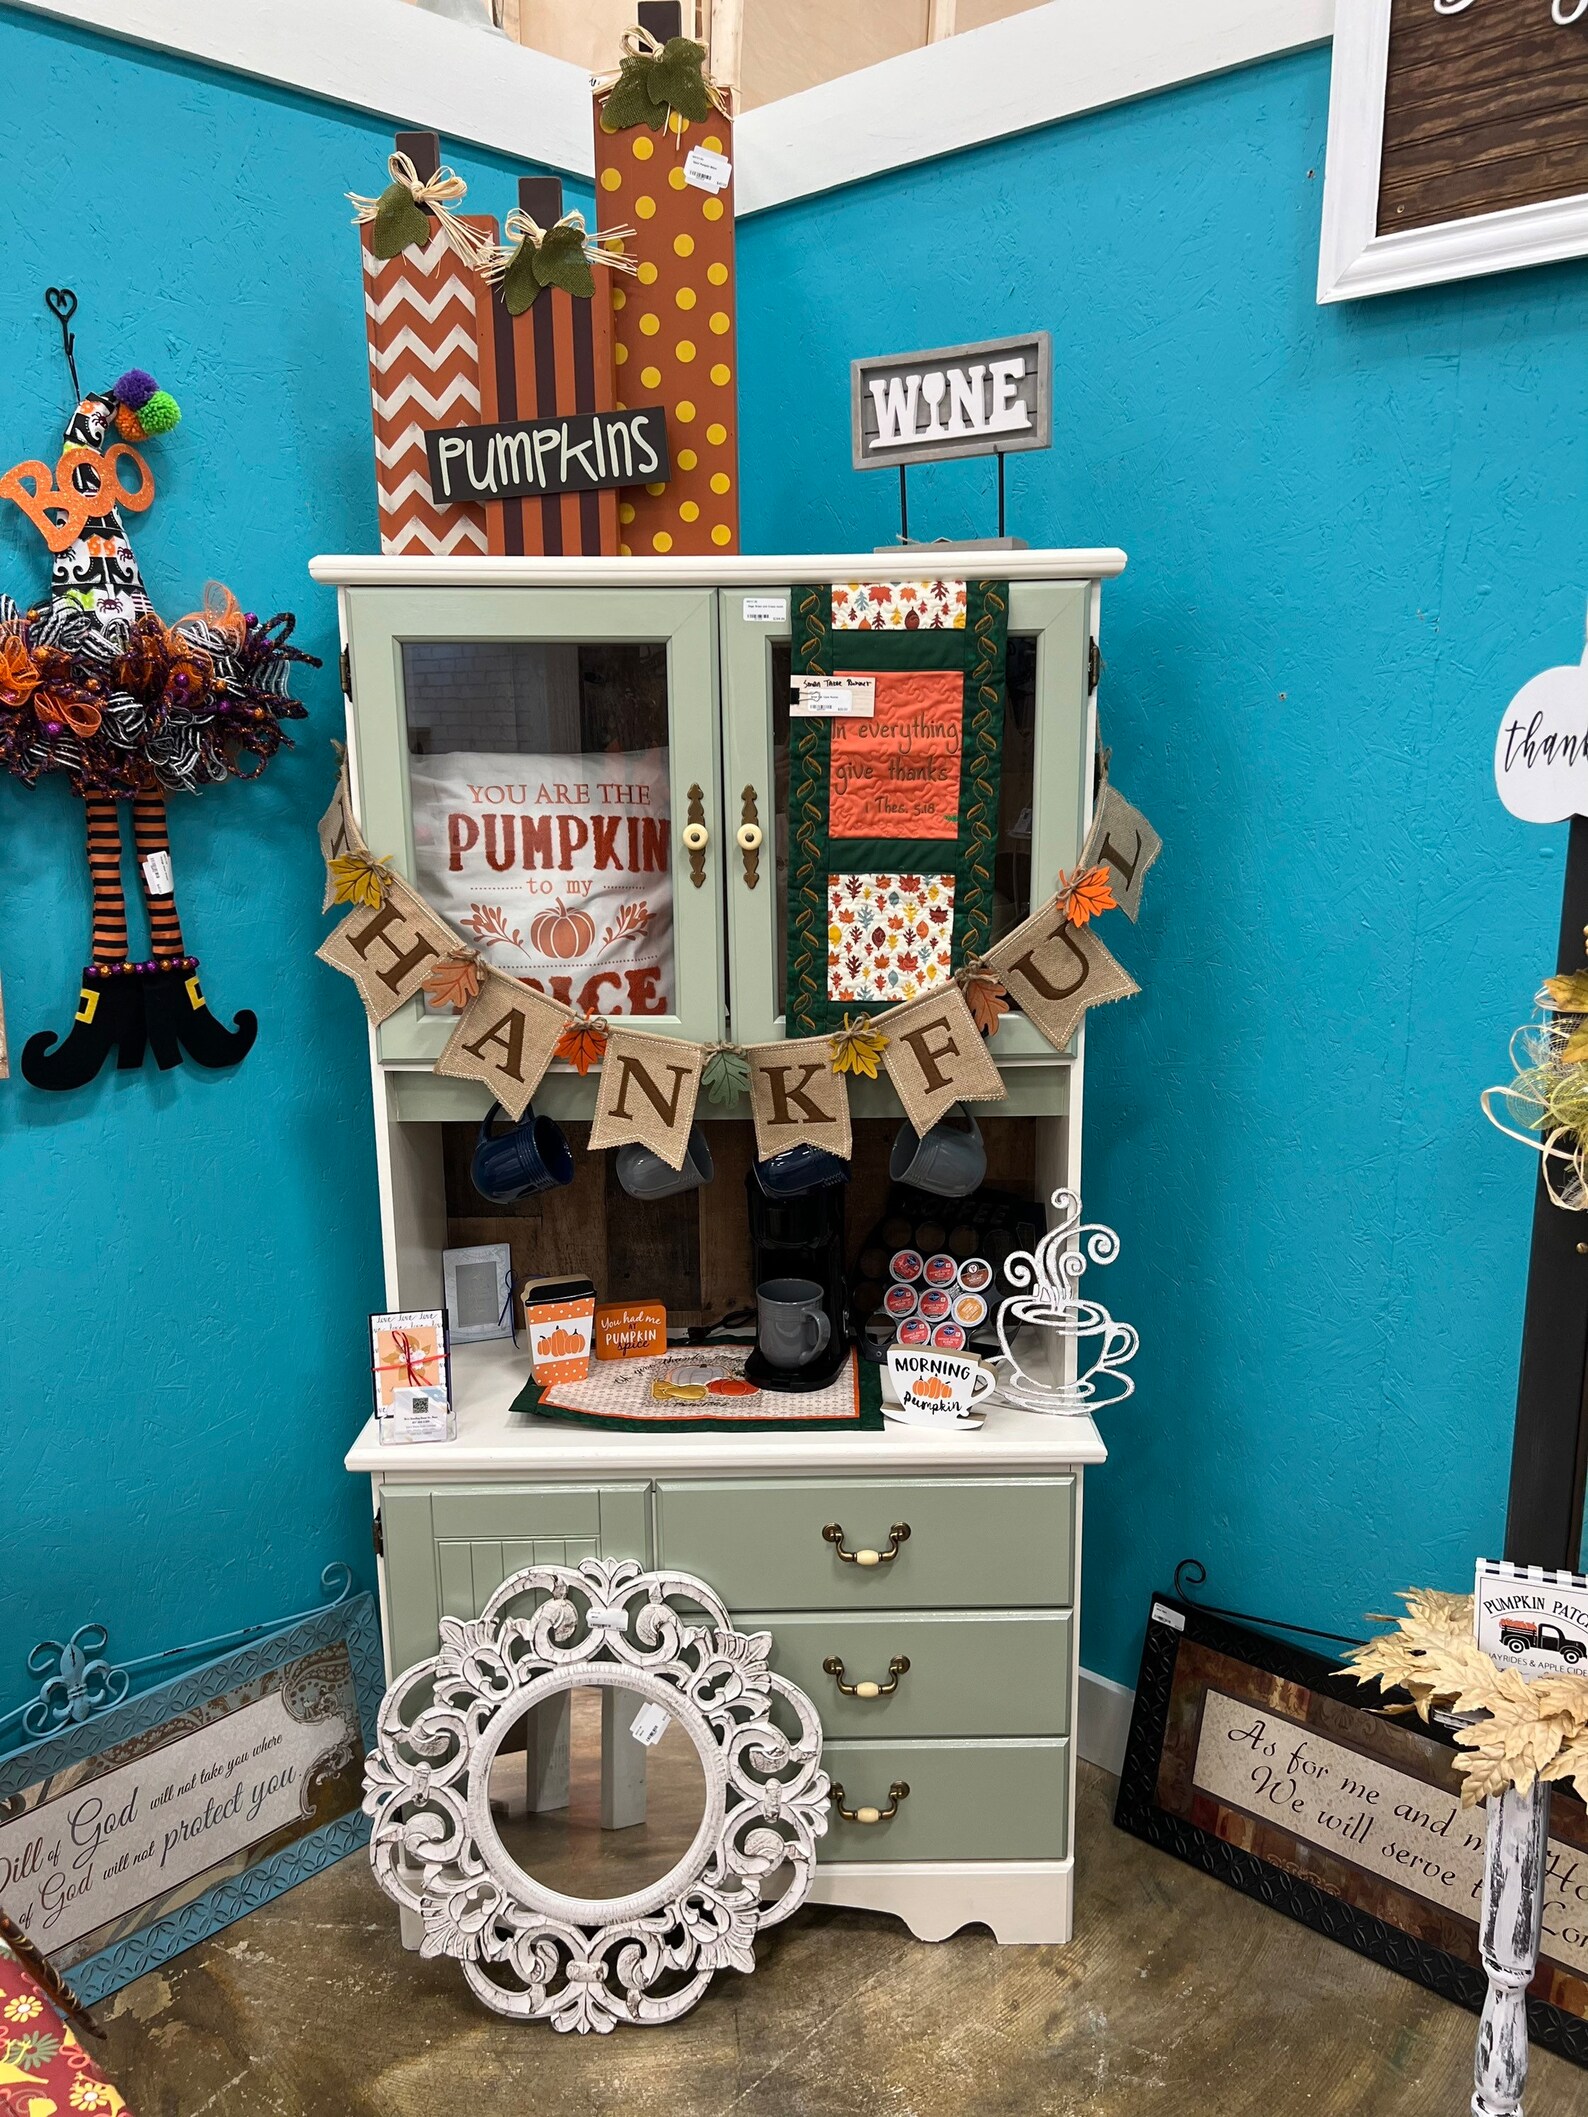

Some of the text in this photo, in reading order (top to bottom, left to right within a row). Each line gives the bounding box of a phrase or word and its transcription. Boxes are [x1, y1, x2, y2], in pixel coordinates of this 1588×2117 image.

[0, 443, 156, 553] BOO
[858, 712, 960, 755] everything
[834, 755, 949, 796] give thanks
[467, 783, 652, 806] YOU ARE THE
[447, 812, 672, 873] PUMPKIN
[526, 878, 594, 898] to my
[601, 1310, 662, 1331] You had me
[605, 1328, 657, 1346] PUMPKIN
[617, 1340, 650, 1357] spice
[895, 1357, 971, 1380] MORNING
[1483, 1595, 1546, 1614] PUMPKIN
[1488, 1653, 1528, 1667] AYRIDES
[1537, 1662, 1565, 1673] APPLE
[1227, 1719, 1277, 1757] As
[1286, 1741, 1329, 1779] for
[1340, 1777, 1380, 1805] me
[1393, 1808, 1457, 1838] and
[48, 1840, 62, 1867] of
[67, 1786, 139, 1870] God
[150, 1784, 175, 1810] will
[177, 1773, 199, 1797] not
[200, 1762, 224, 1785] take
[225, 1752, 249, 1778] you
[252, 1734, 283, 1758] where
[1251, 1765, 1456, 1886] We will serve
[19, 1902, 34, 1929] of
[38, 1862, 94, 1929] God
[103, 1853, 130, 1880] will
[133, 1840, 155, 1866] not
[160, 1781, 244, 1867] protect
